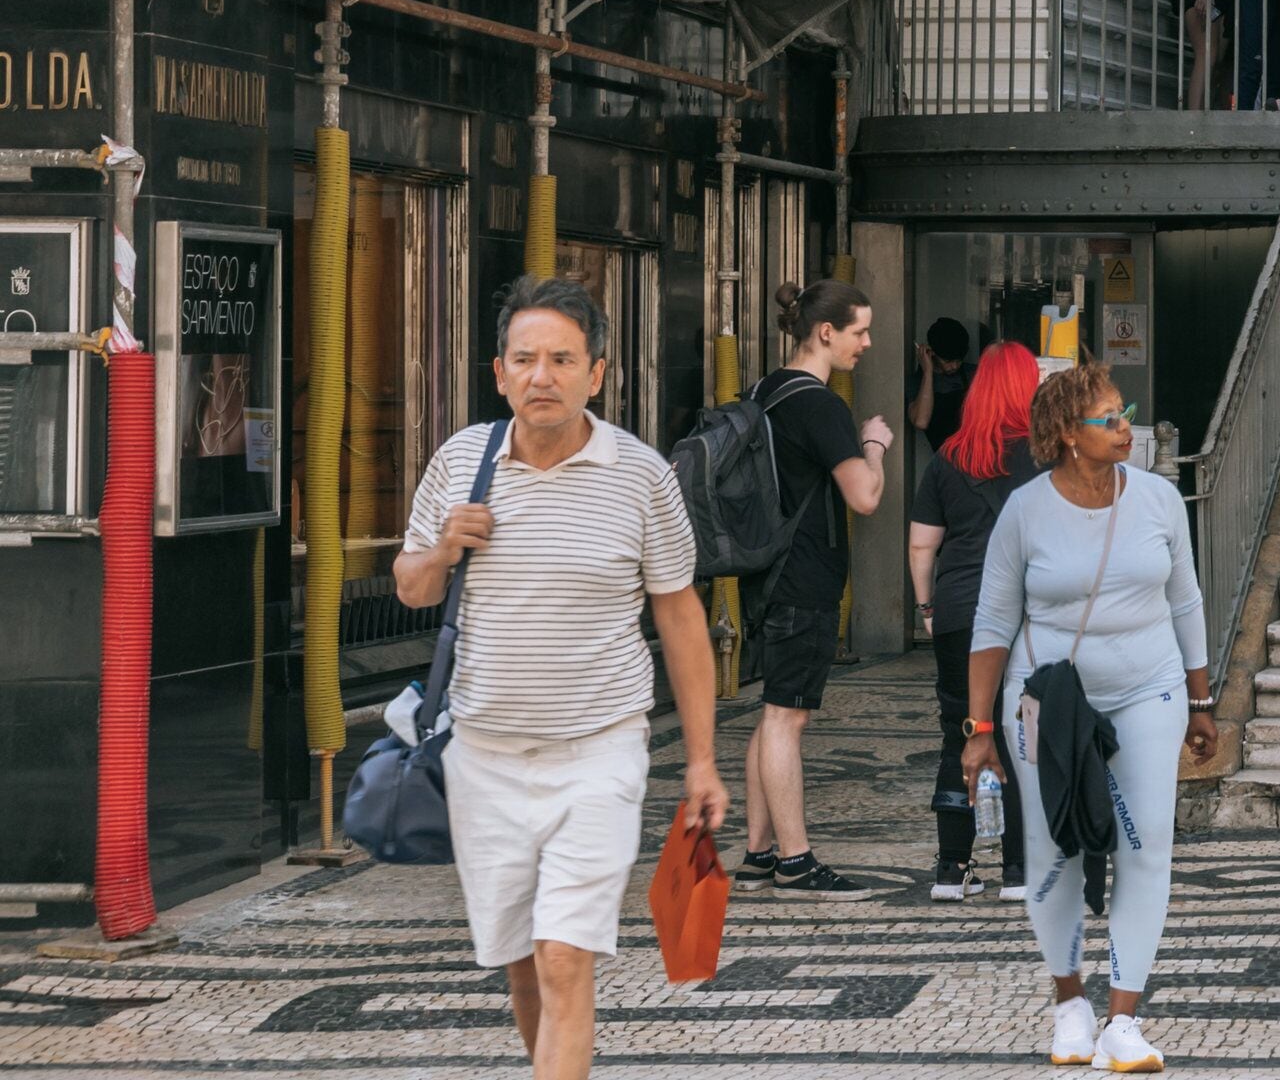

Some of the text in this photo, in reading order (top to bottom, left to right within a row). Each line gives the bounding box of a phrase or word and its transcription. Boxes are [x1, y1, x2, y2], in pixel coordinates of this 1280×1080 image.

[184, 253, 239, 298] ESPAÇO
[181, 299, 255, 336] SARMENTO
[1112, 793, 1142, 851] ARMOUR
